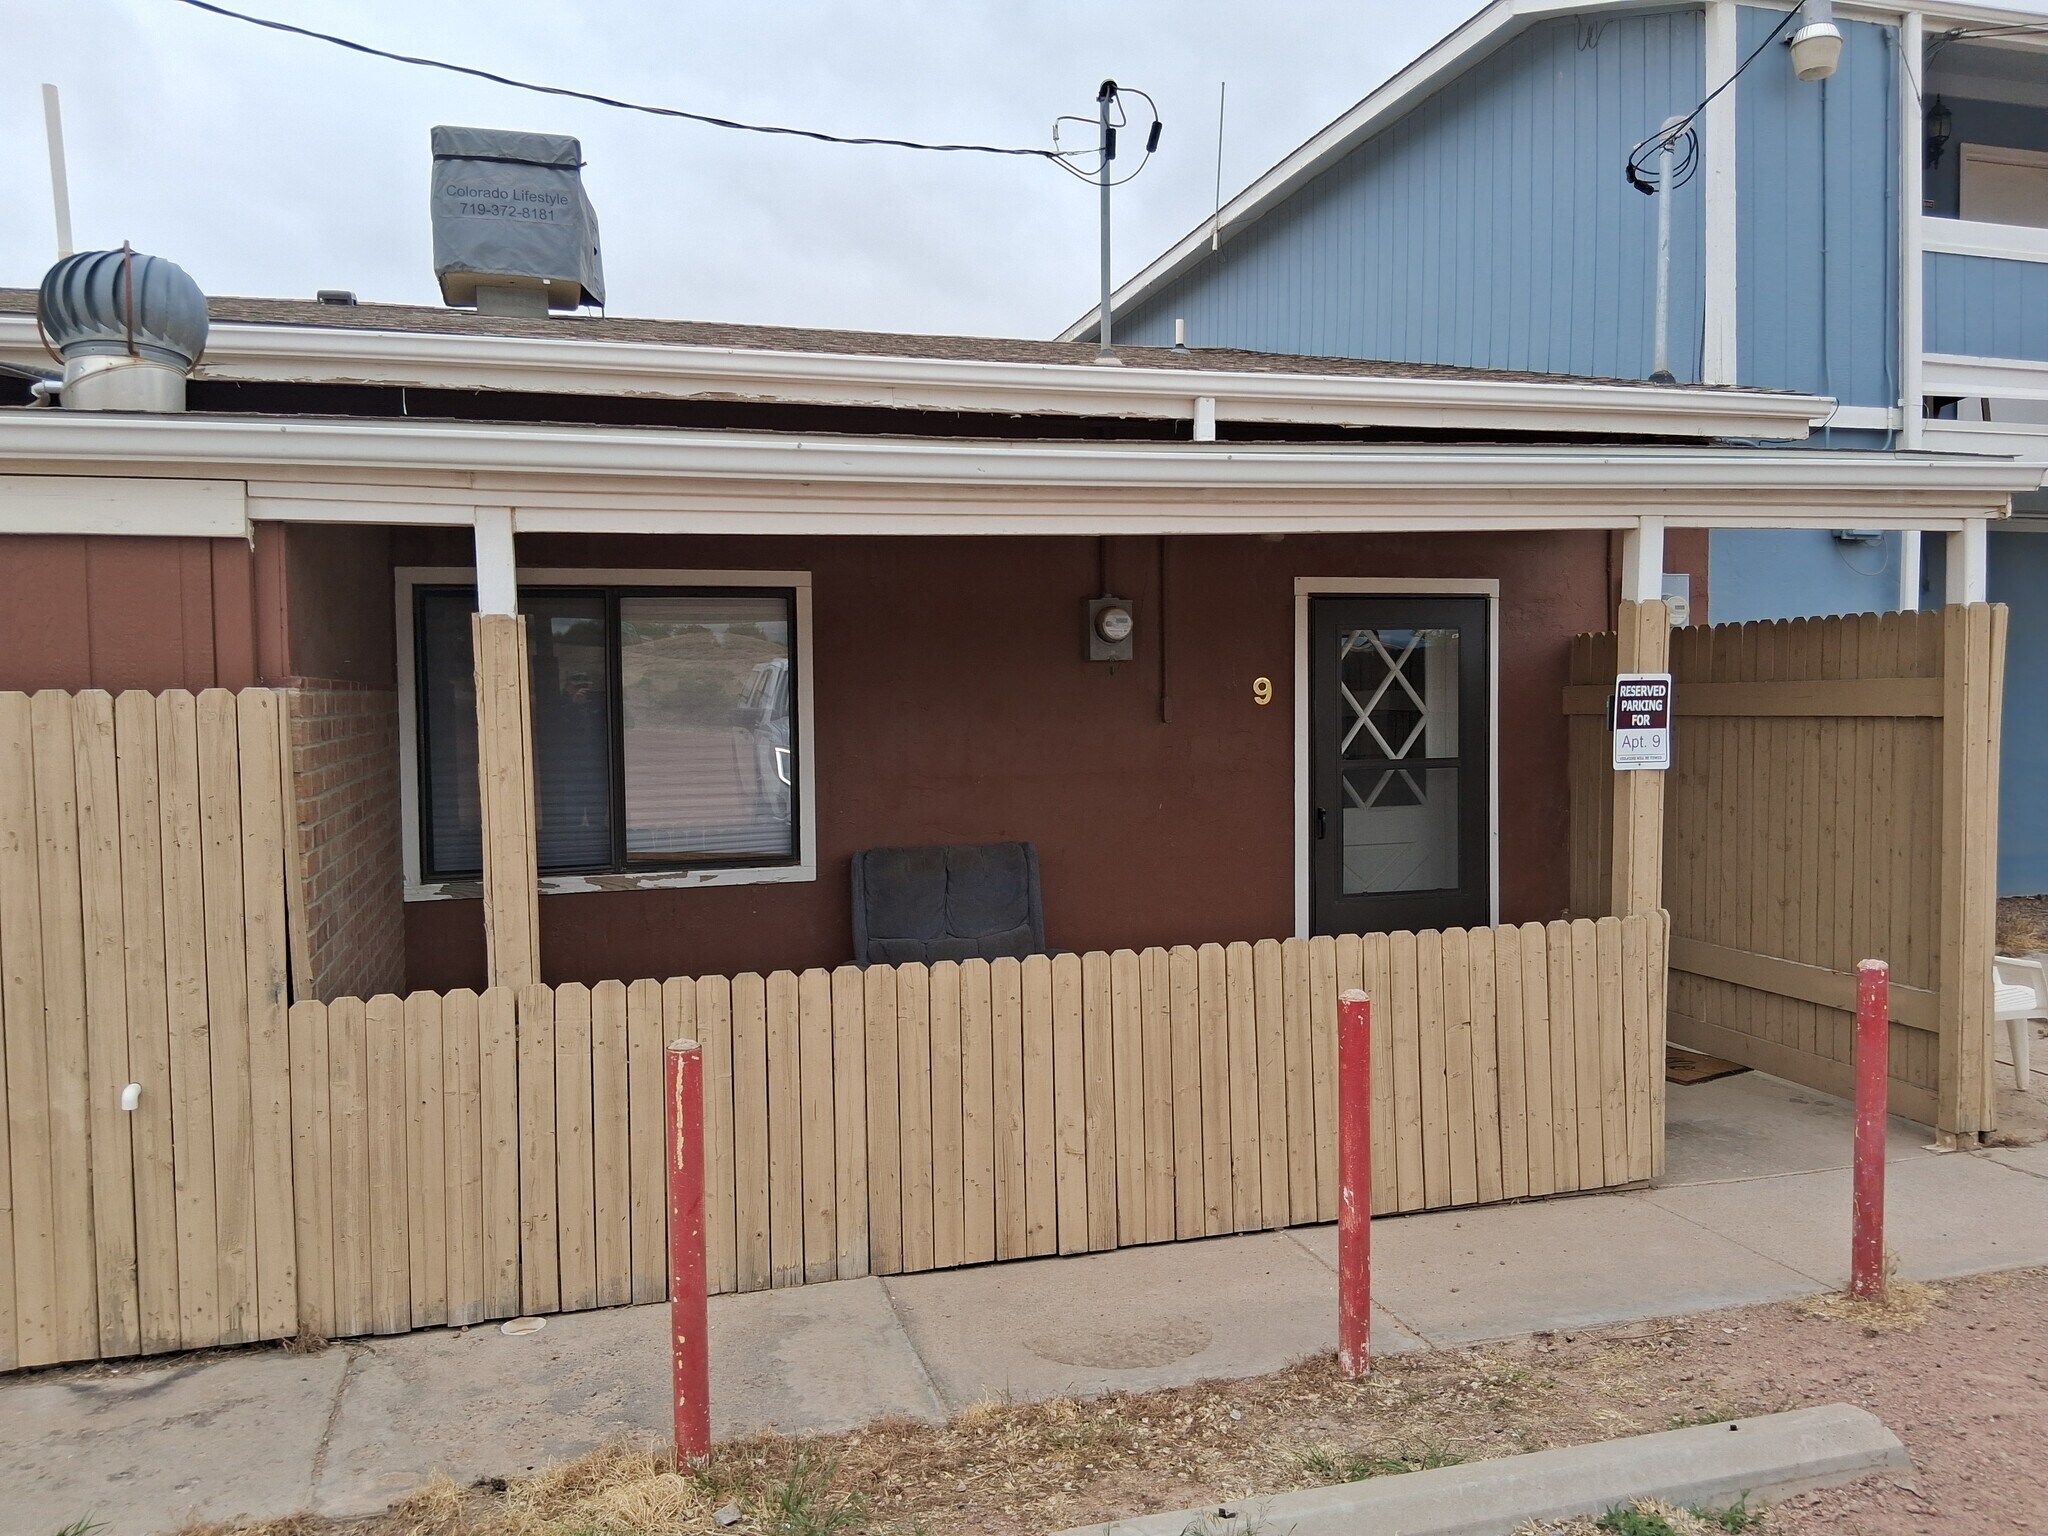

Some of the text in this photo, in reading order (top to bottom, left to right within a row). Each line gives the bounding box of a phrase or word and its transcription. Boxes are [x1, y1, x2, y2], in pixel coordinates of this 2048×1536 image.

[446, 184, 569, 207] Colorado Lifestyle
[460, 203, 555, 221] 719-372-8181
[1253, 677, 1272, 705] 9
[1620, 685, 1666, 697] RESERVED
[1621, 699, 1663, 712] PARKING
[1631, 714, 1651, 726] FOR
[1621, 734, 1661, 751] Apt. 9
